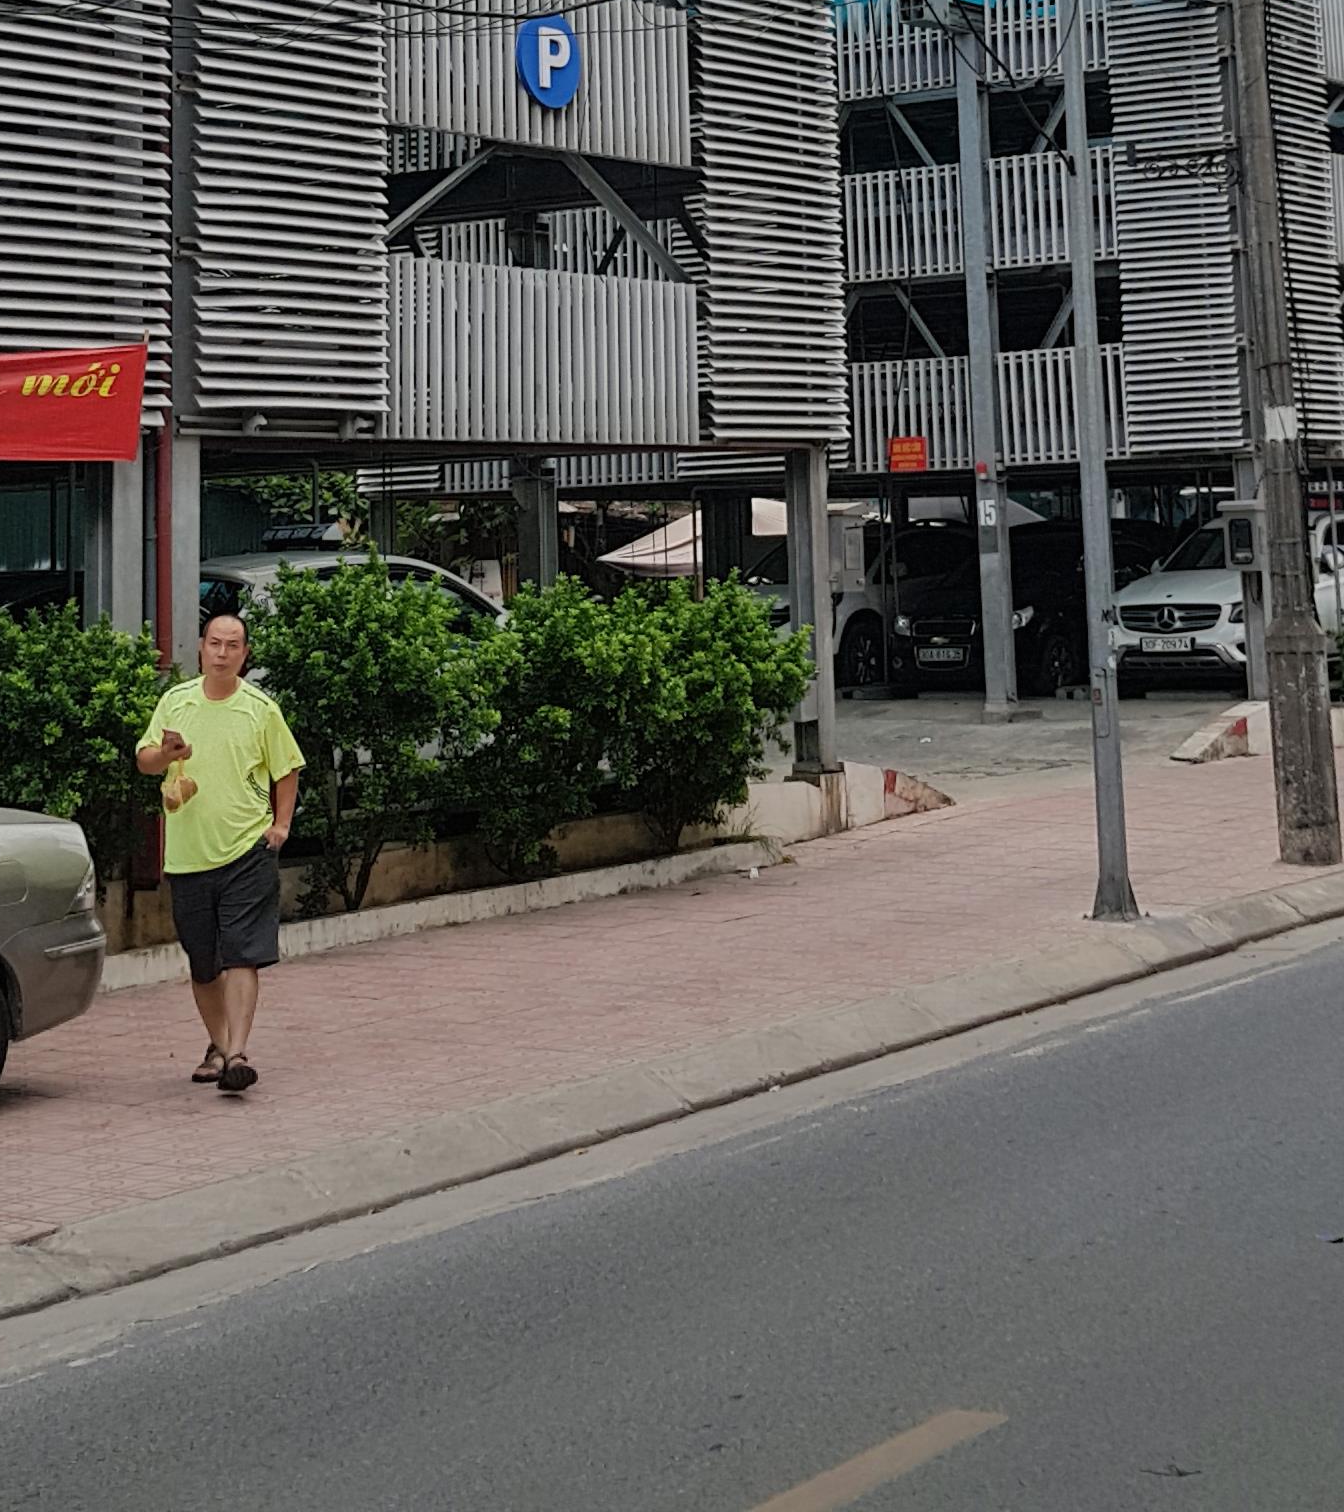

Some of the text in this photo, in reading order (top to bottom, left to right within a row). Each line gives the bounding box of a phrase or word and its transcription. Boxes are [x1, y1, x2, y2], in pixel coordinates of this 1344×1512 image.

[538, 26, 571, 88] P
[19, 362, 122, 399] mới
[979, 500, 996, 525] 15
